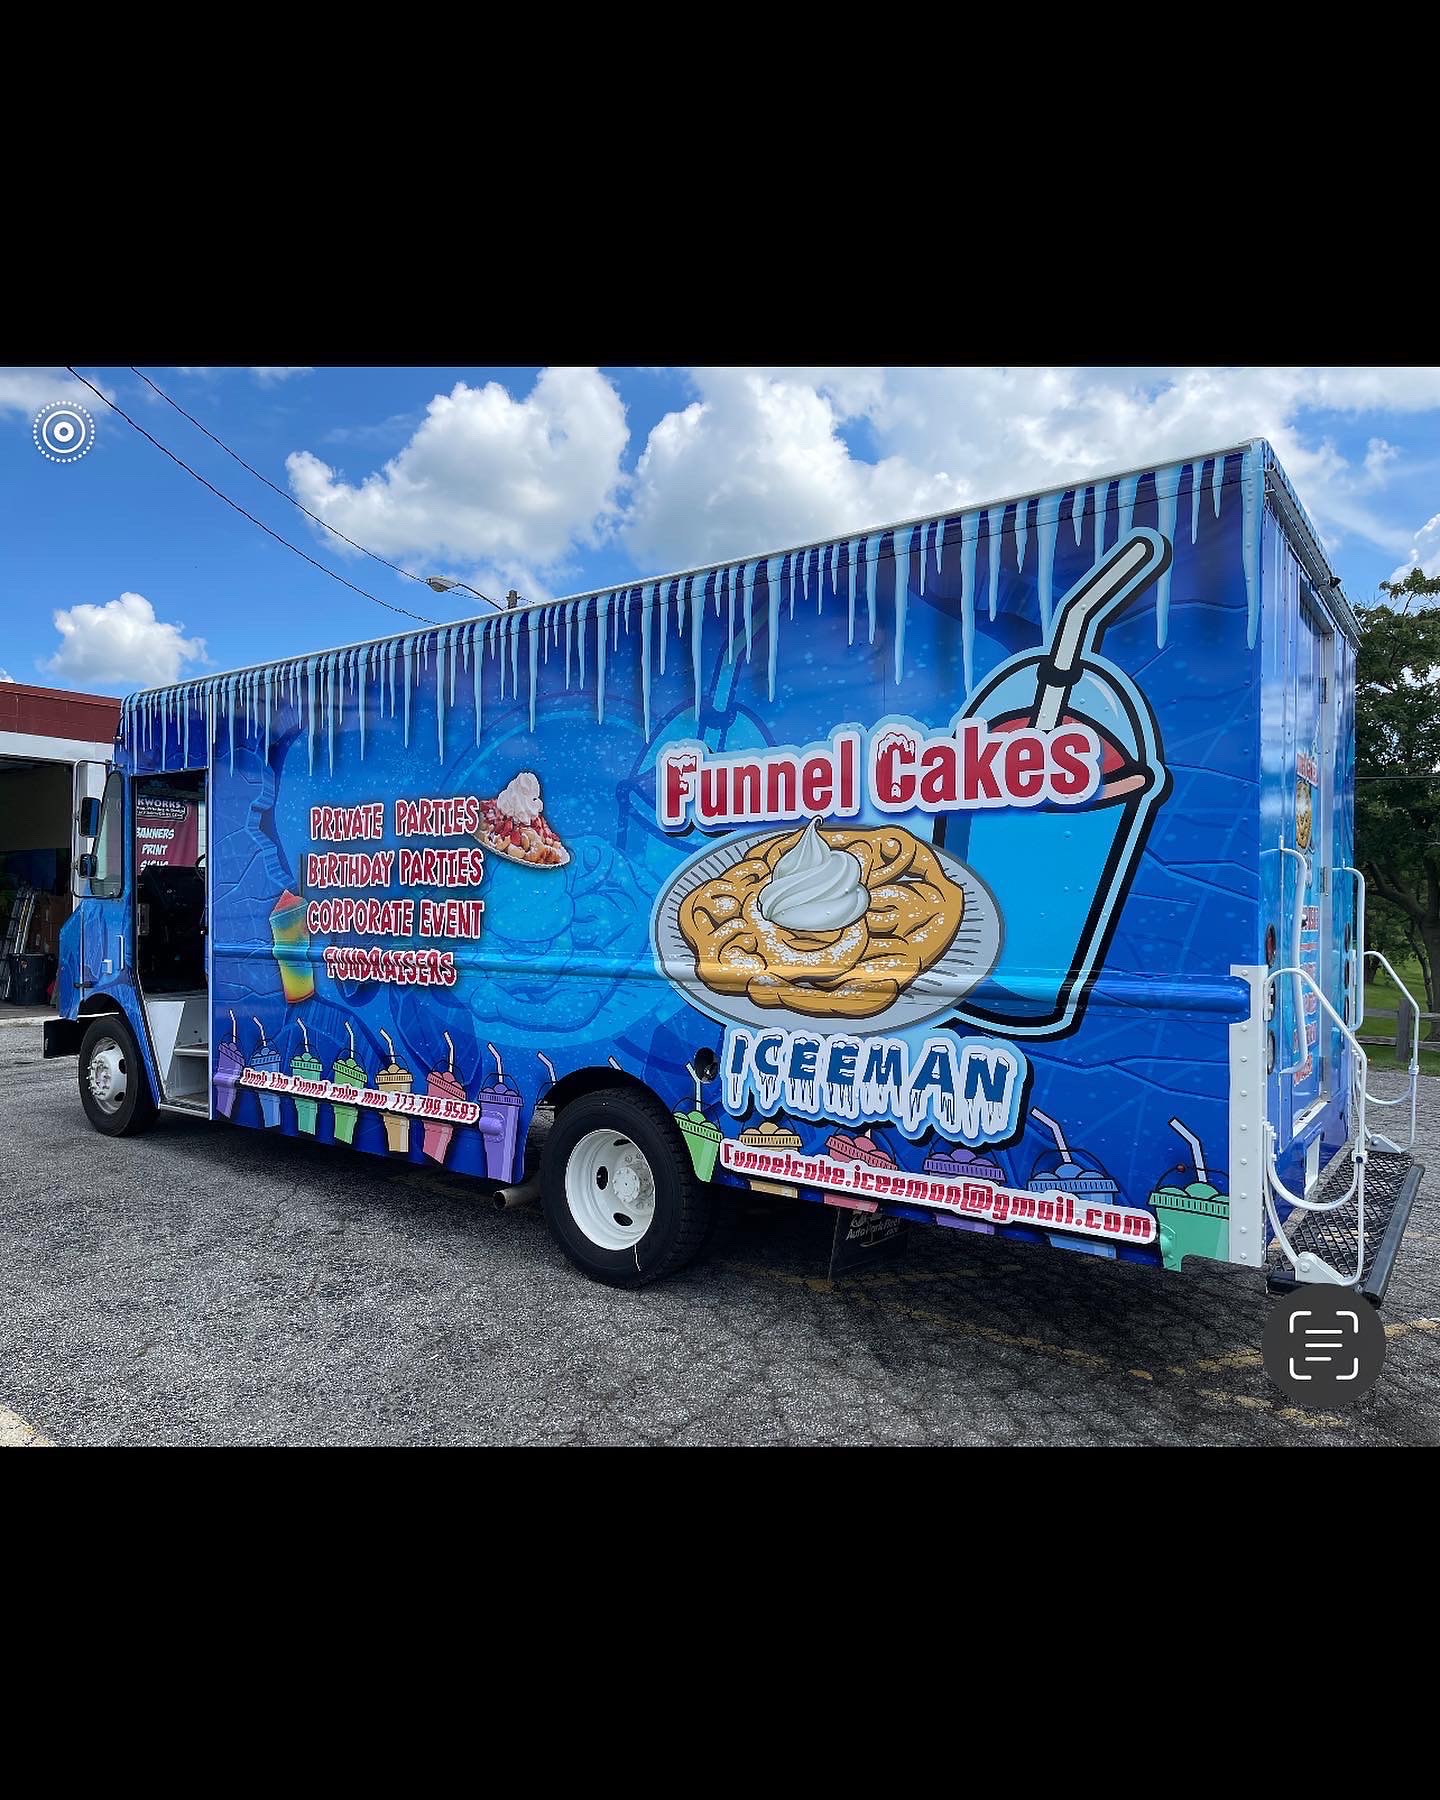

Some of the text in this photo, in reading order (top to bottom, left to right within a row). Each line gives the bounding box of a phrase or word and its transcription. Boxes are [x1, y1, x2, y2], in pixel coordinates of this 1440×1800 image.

[665, 725, 1091, 819] Funnel Cakes
[311, 797, 479, 841] PRIVATE PARTIES
[141, 844, 168, 855] PRINT
[307, 849, 484, 888] BIRTHDAY PARTIES
[307, 899, 484, 938] CORPORATE EVENT
[324, 947, 457, 986] FUNDRAISERS
[242, 1069, 268, 1087] Book
[269, 1072, 289, 1089] the
[730, 1033, 1010, 1124] ICEEMAN
